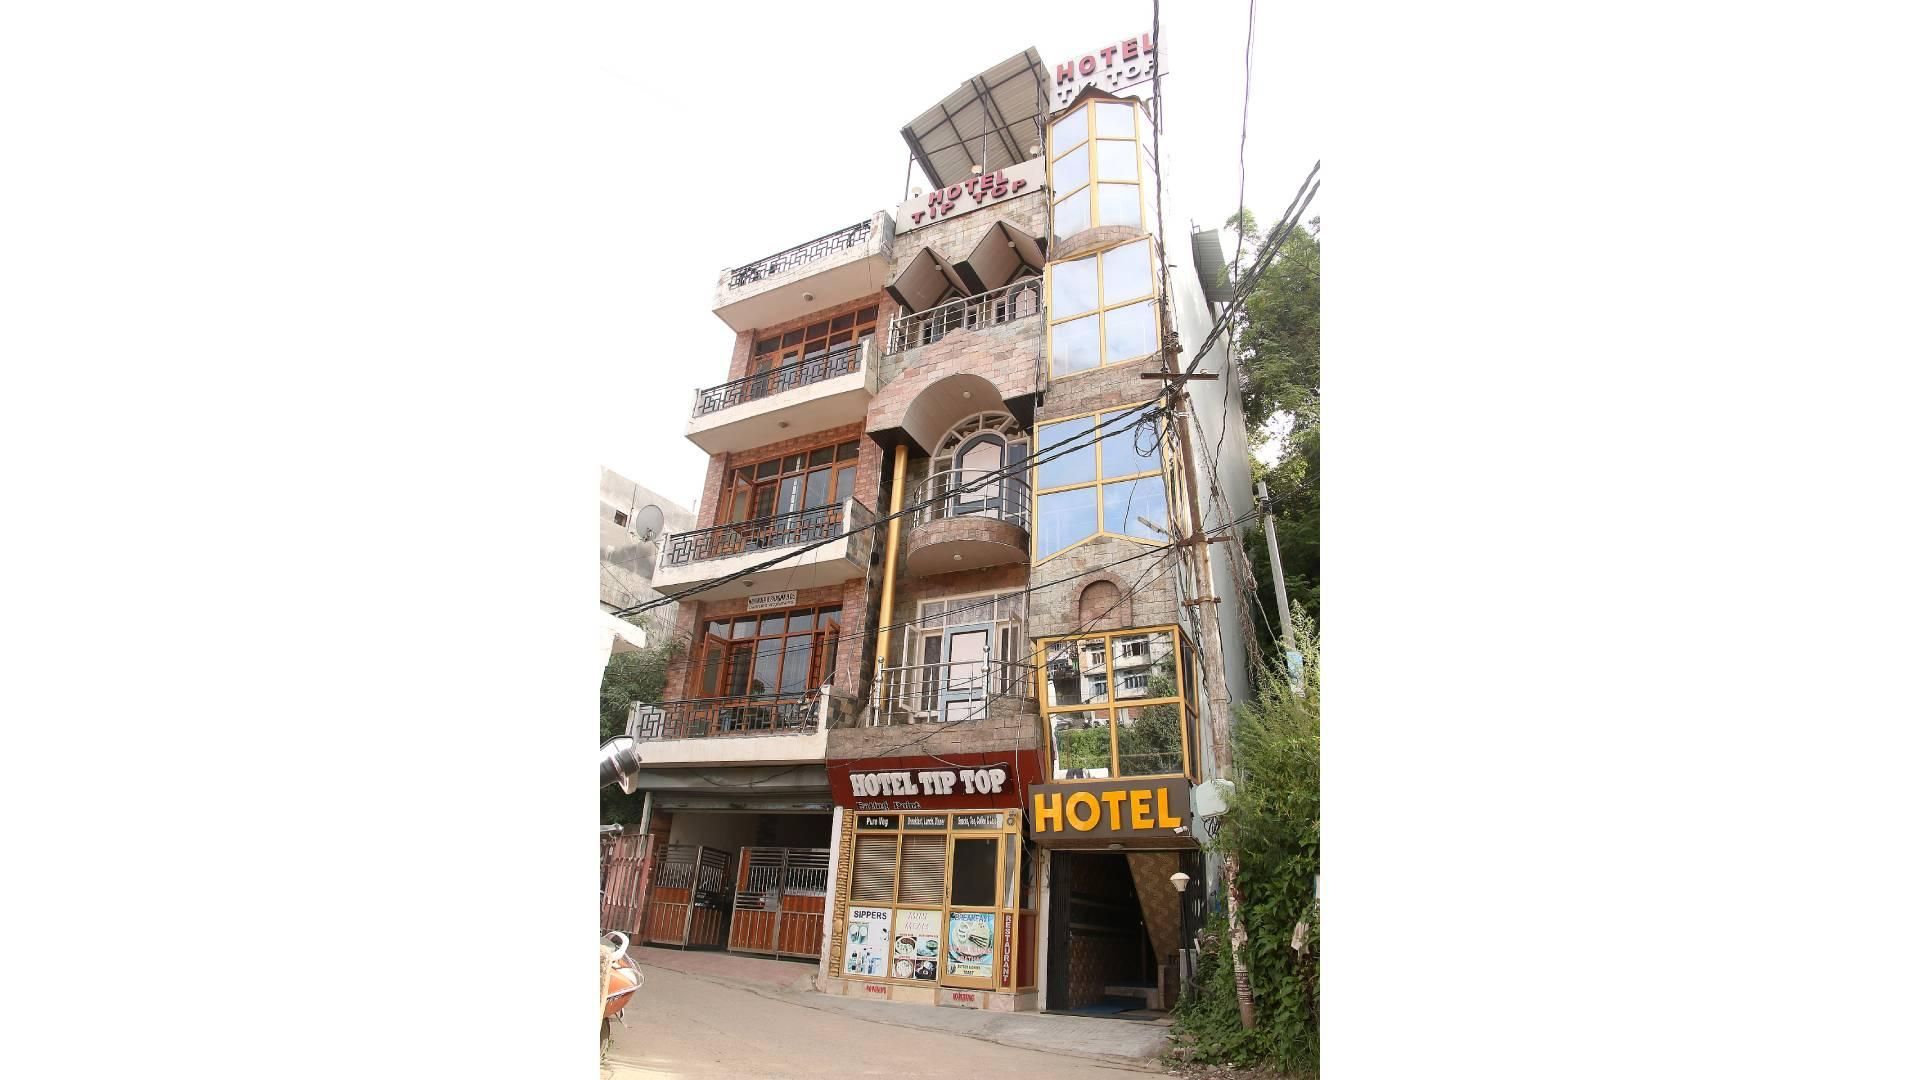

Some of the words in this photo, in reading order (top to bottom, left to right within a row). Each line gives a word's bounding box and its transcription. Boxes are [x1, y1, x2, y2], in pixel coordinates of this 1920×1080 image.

[1057, 32, 1154, 86] HOTEL
[912, 201, 955, 224] TIP
[973, 179, 1027, 204] TOP
[928, 169, 1008, 207] HOTEL
[849, 771, 919, 797] HOTEL
[918, 770, 957, 796] TIP
[959, 768, 1007, 795] TOP
[866, 816, 878, 826] Pure
[878, 816, 889, 827] Veg
[1034, 787, 1181, 833] HOTEL
[853, 910, 887, 920] SIPPERS
[1002, 914, 1012, 982] RESTAURANT
